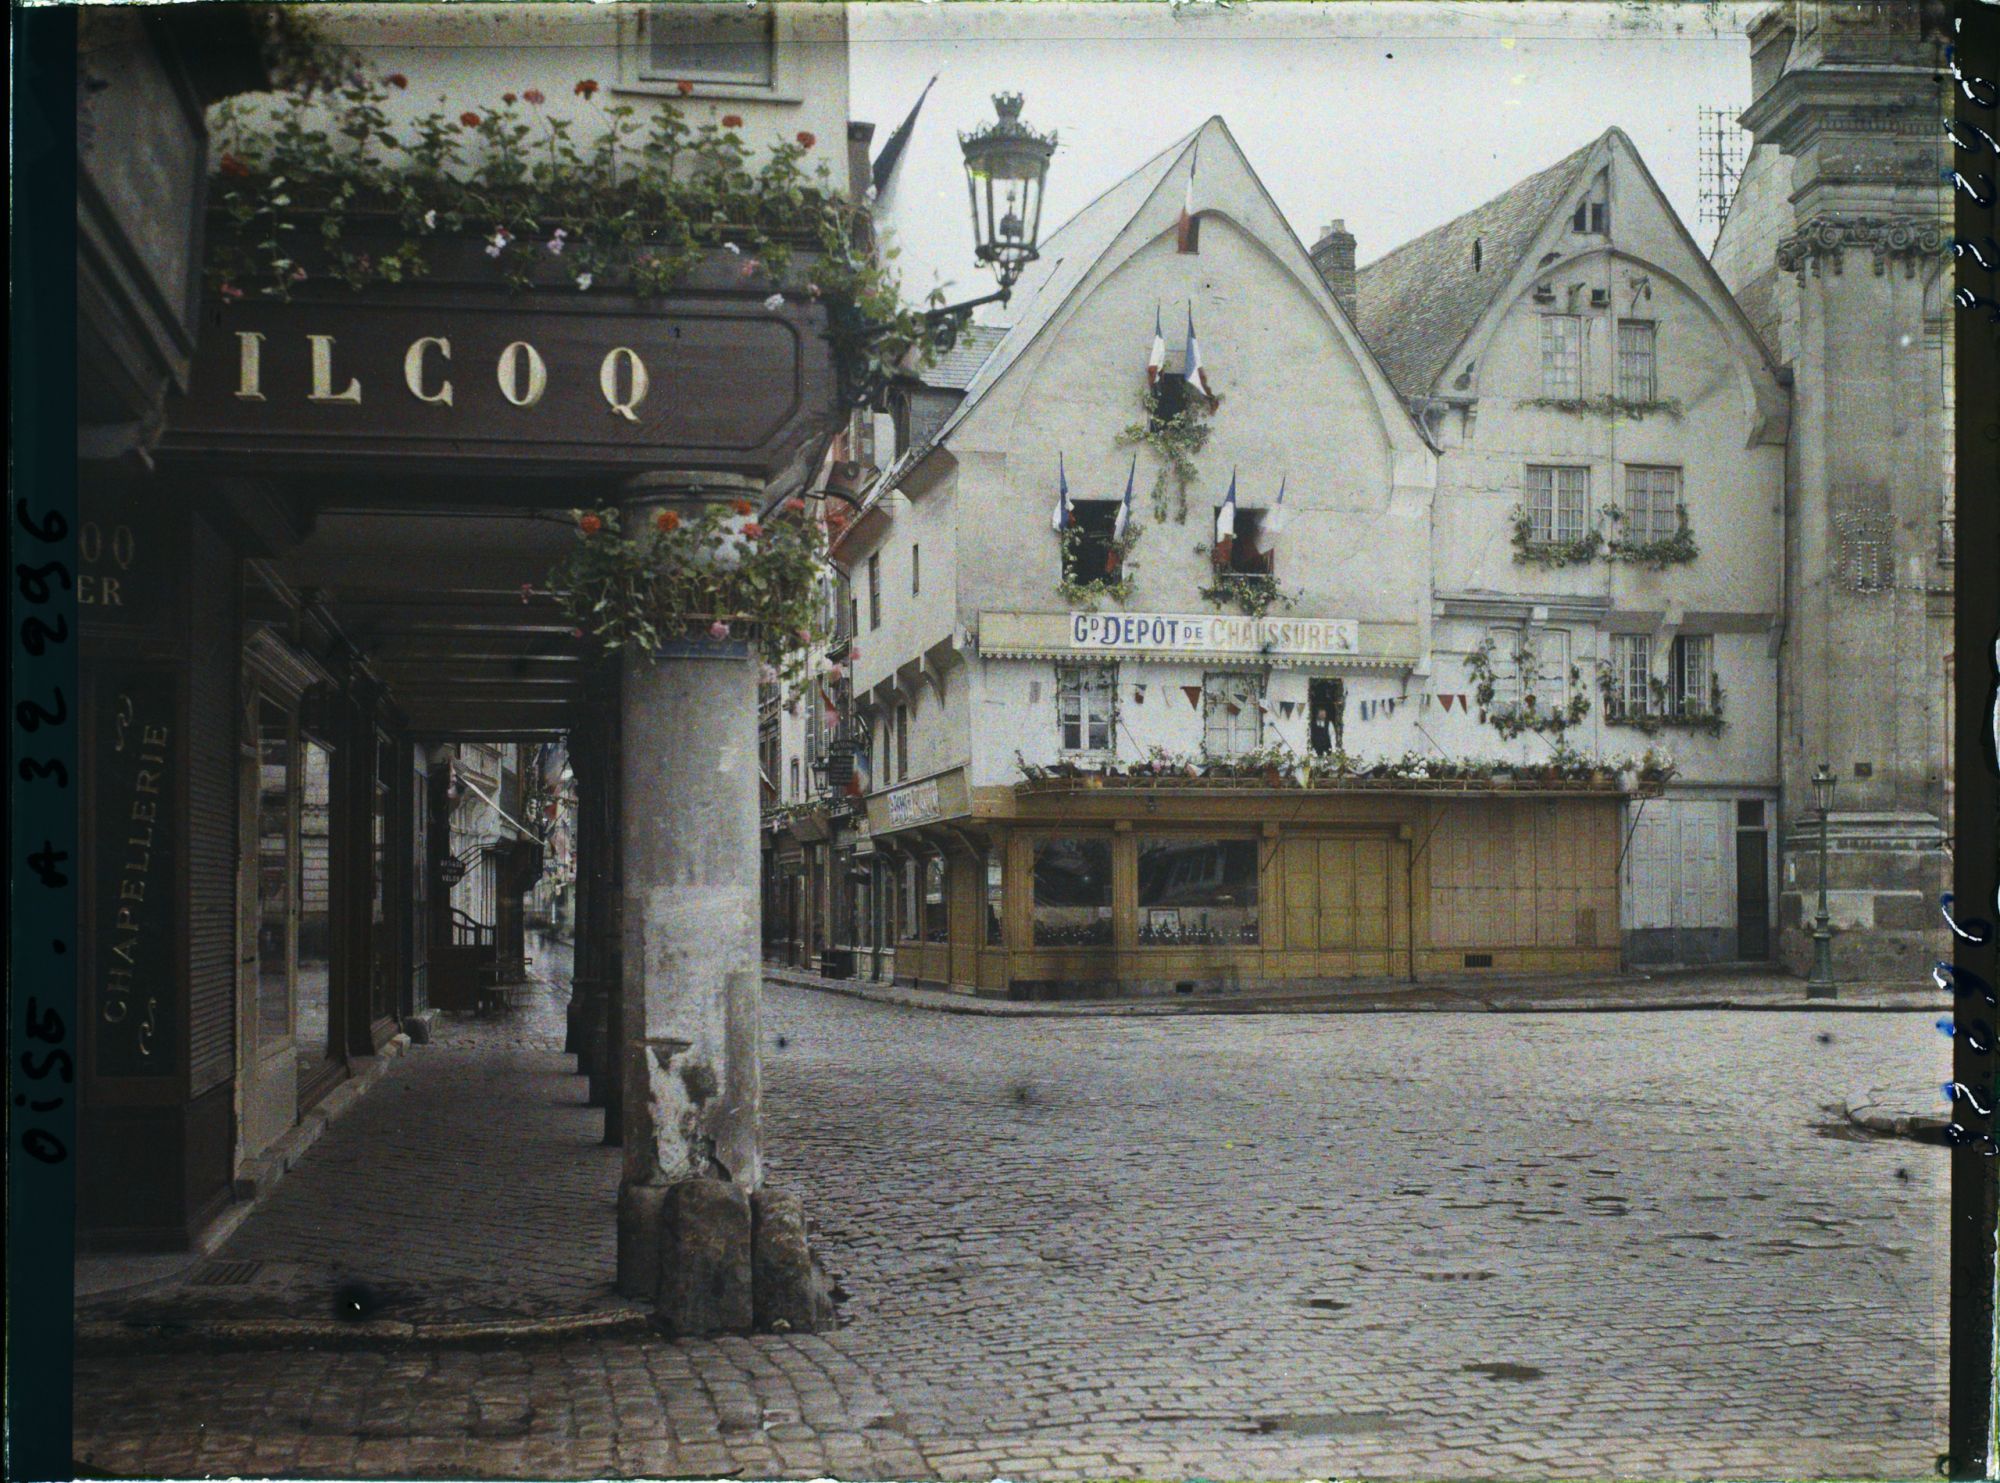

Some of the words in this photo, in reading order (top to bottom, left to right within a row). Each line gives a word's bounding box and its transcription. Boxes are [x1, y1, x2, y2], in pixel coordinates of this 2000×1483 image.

[1100, 616, 1179, 645] DÉPÔT
[1209, 617, 1350, 650] CHAUSSURES
[103, 724, 169, 1023] CHAPELLERIE
